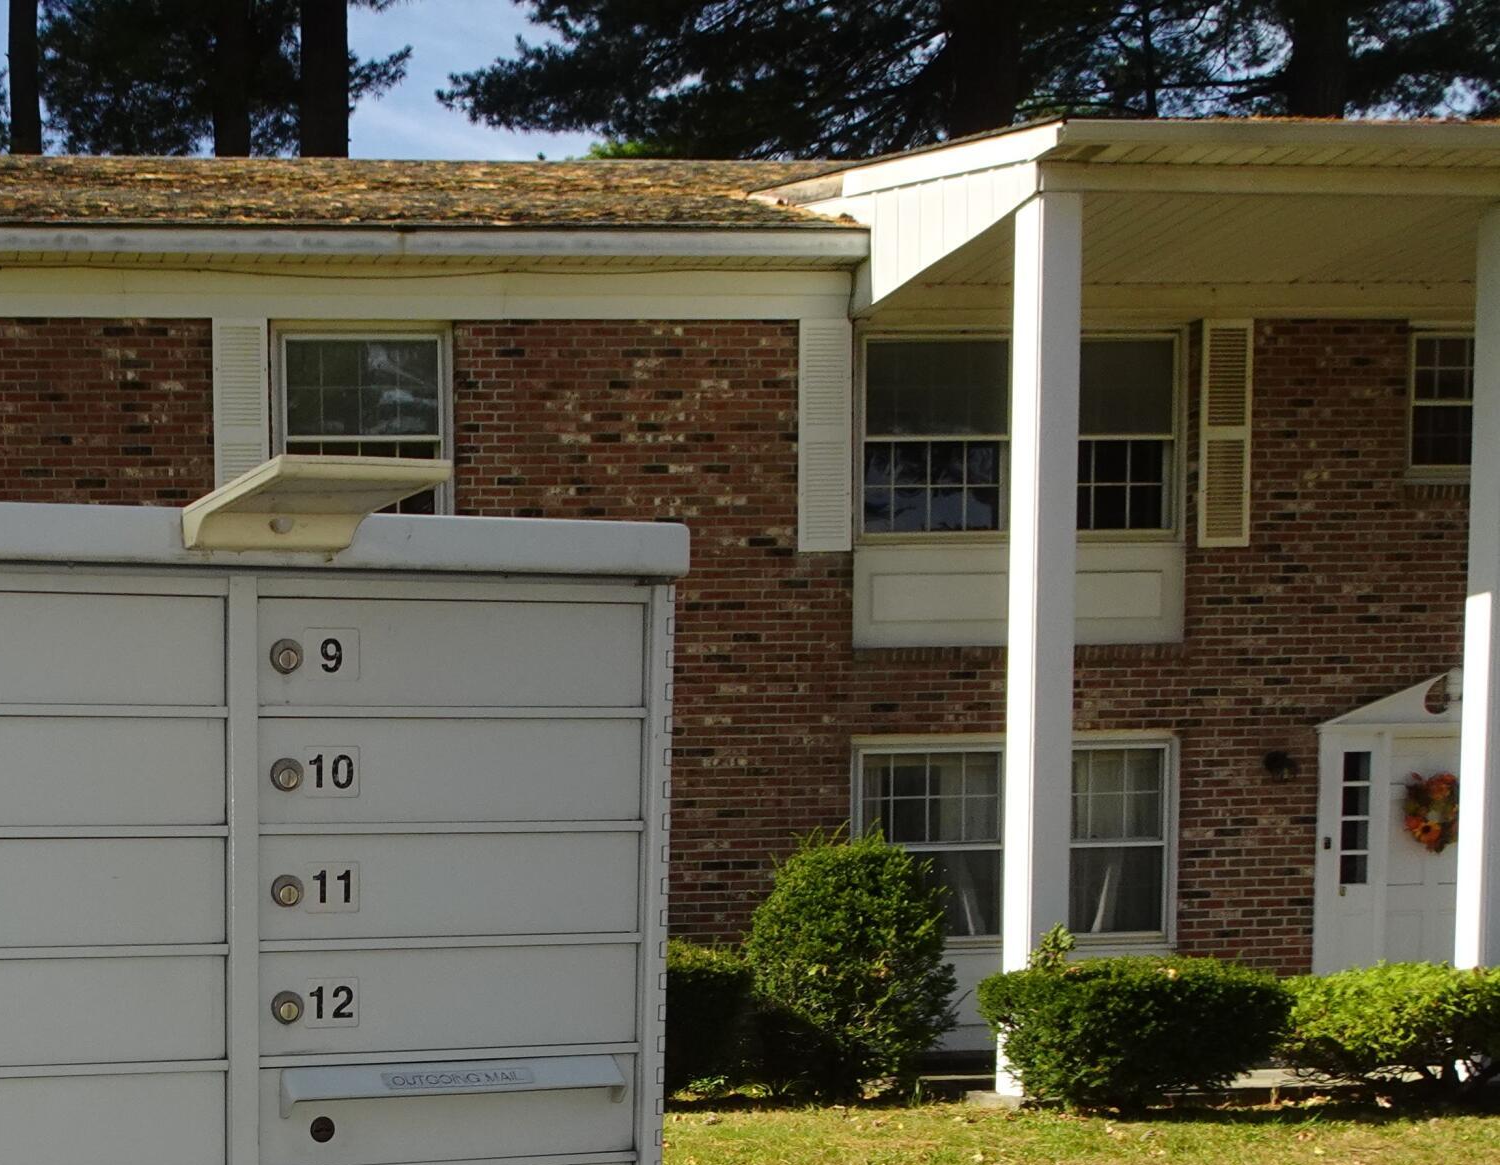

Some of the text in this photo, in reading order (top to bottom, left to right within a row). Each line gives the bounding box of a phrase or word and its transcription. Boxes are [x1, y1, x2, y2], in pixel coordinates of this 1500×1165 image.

[320, 638, 343, 673] 9
[308, 754, 354, 789] 10
[312, 869, 351, 904] 11
[309, 985, 354, 1020] 12
[485, 1070, 524, 1083] MAIL
